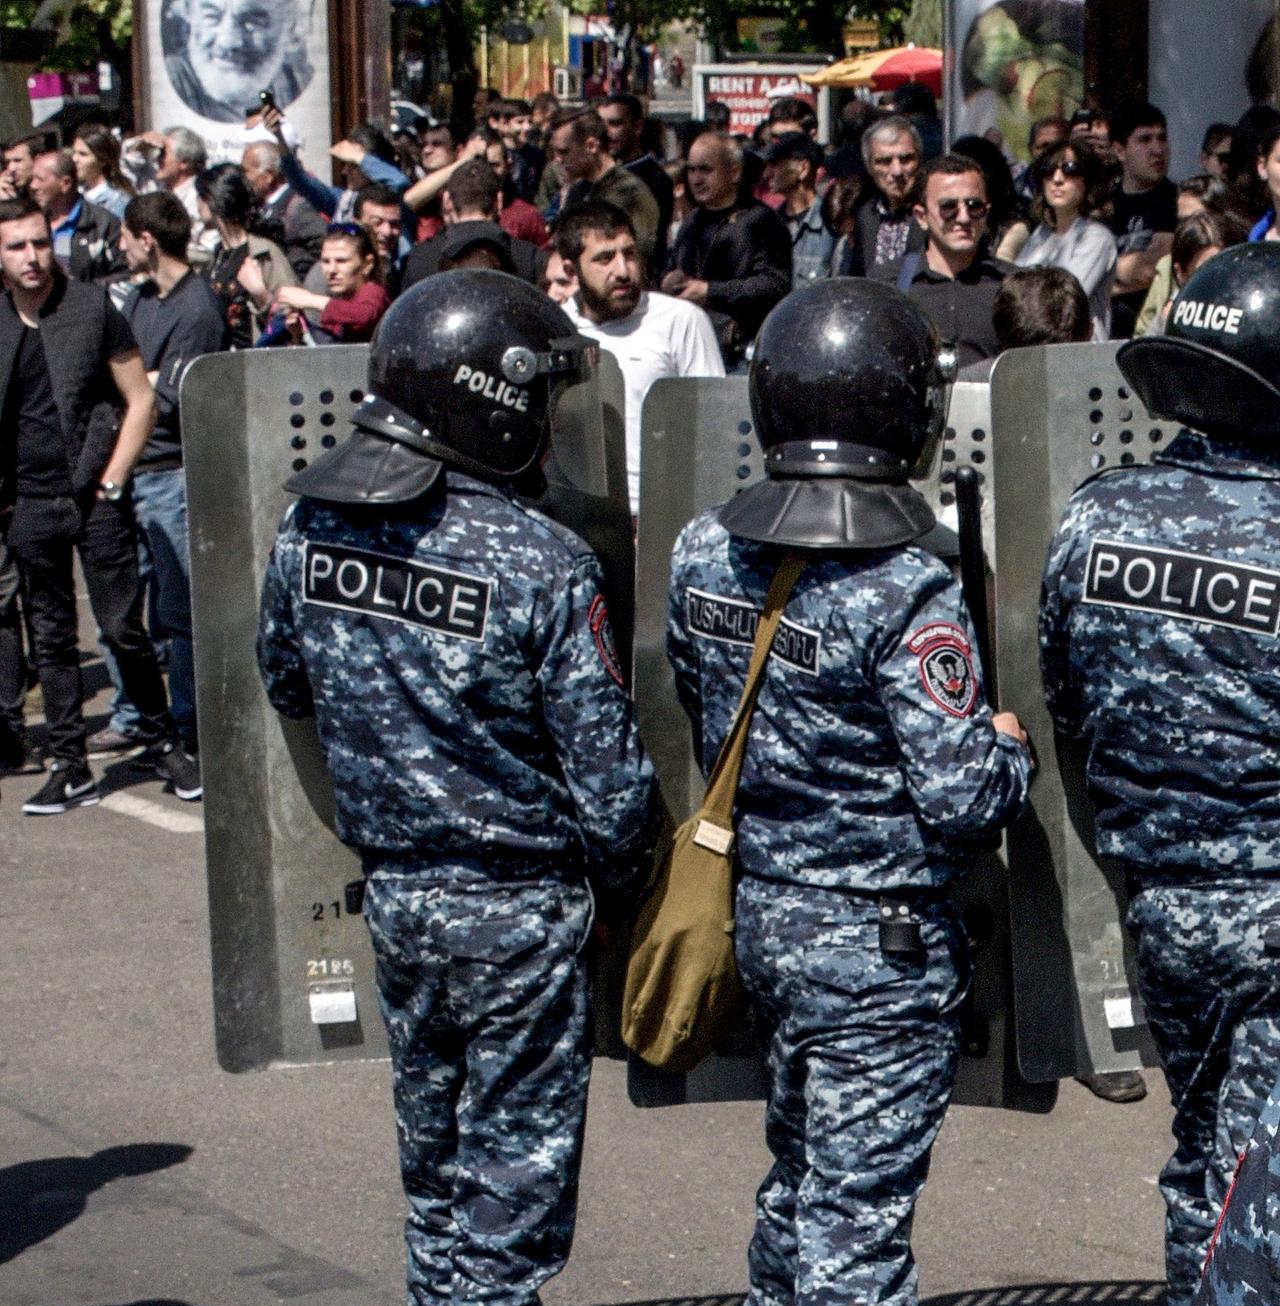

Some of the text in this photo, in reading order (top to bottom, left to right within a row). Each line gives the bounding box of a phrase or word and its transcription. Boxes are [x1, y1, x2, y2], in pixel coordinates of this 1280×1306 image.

[708, 76, 755, 94] RENT
[760, 77, 772, 95] A
[1173, 300, 1244, 335] POLICE
[453, 364, 529, 413] POLICE
[310, 553, 479, 628] POLICE
[1093, 552, 1276, 623] POLICE
